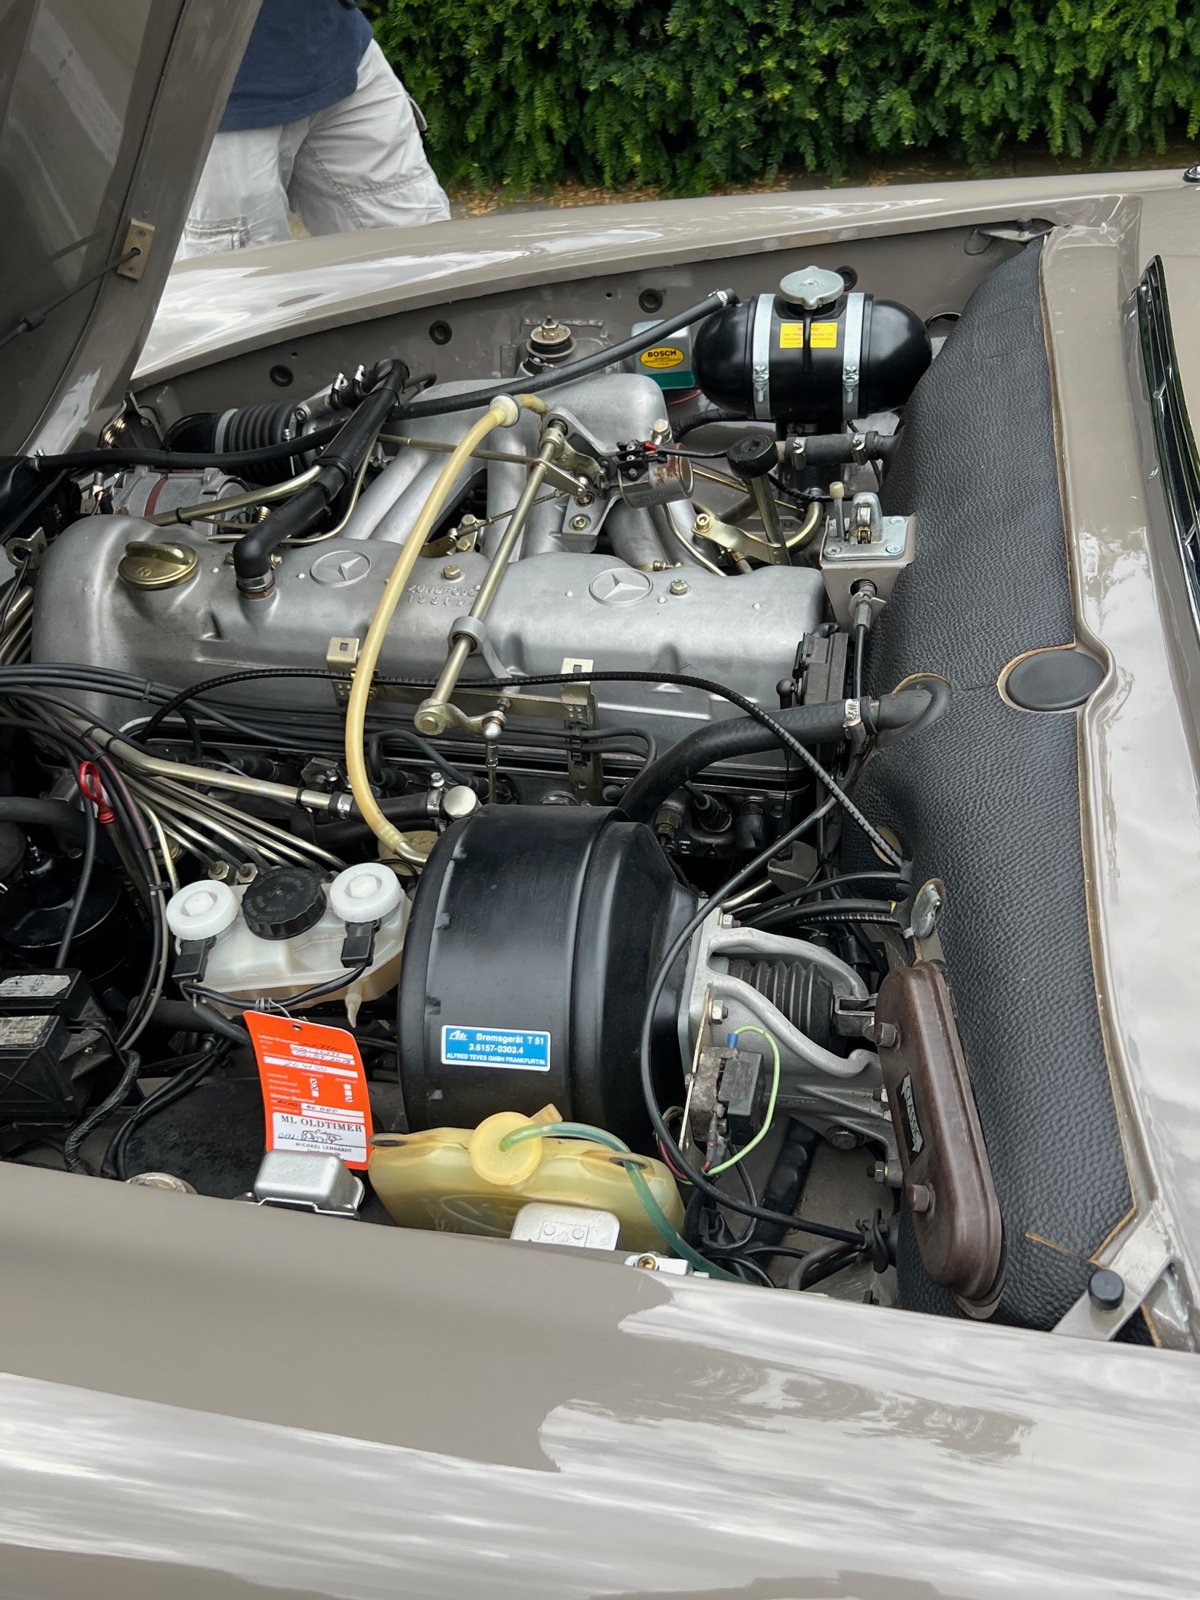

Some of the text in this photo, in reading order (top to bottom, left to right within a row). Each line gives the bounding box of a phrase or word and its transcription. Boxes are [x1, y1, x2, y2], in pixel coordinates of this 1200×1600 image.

[647, 350, 677, 358] BOSCH
[476, 1033, 524, 1044] Bremsgerät
[527, 1036, 534, 1044] T
[534, 1037, 544, 1045] 51
[469, 1043, 524, 1054] 3.6157-0303.4
[446, 1052, 468, 1060] ALFRED
[281, 1115, 363, 1132] ML OLDTIMER
[295, 1142, 321, 1150] MICHAEL
